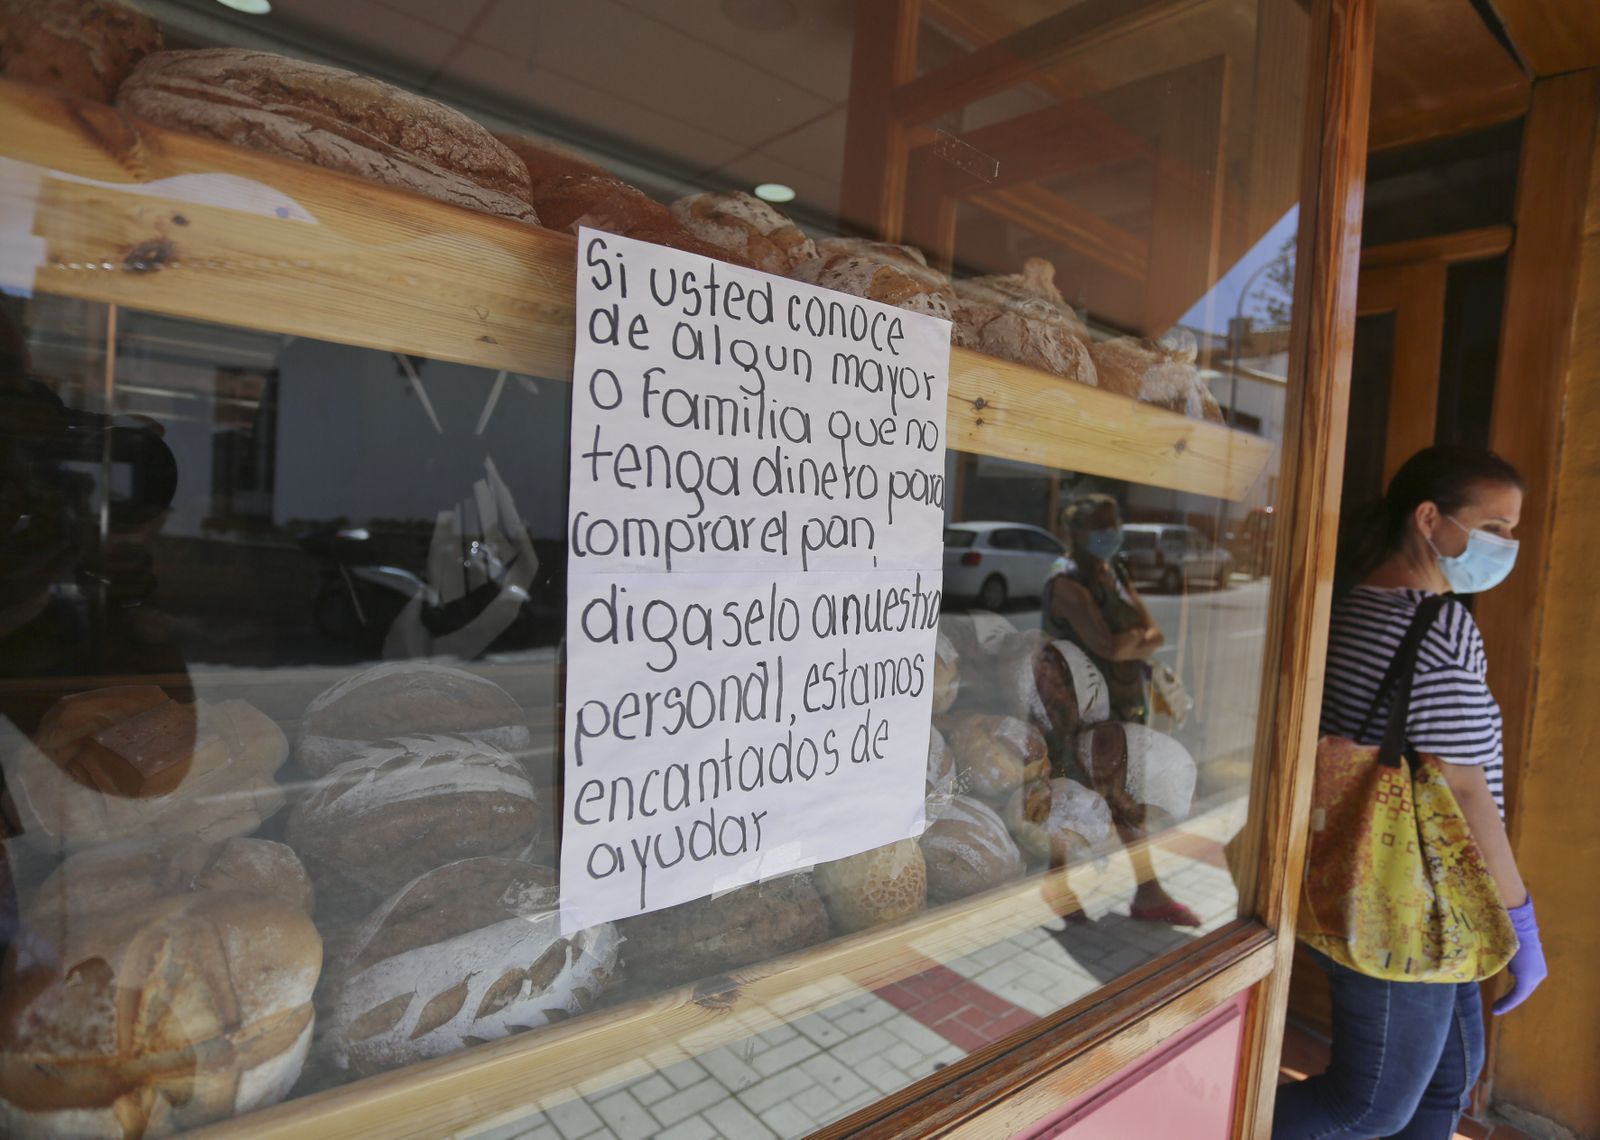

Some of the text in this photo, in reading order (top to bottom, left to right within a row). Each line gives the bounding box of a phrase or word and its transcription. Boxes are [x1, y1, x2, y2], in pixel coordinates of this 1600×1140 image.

[586, 237, 905, 355] Si usted conoce
[588, 303, 936, 416] de algun mayor
[581, 424, 945, 525] tenga dinero para
[905, 418, 939, 452] no
[581, 582, 801, 673] digaselo
[574, 647, 925, 767] personal, estamos
[573, 707, 889, 826] encantados de
[586, 807, 768, 911] ayudar
